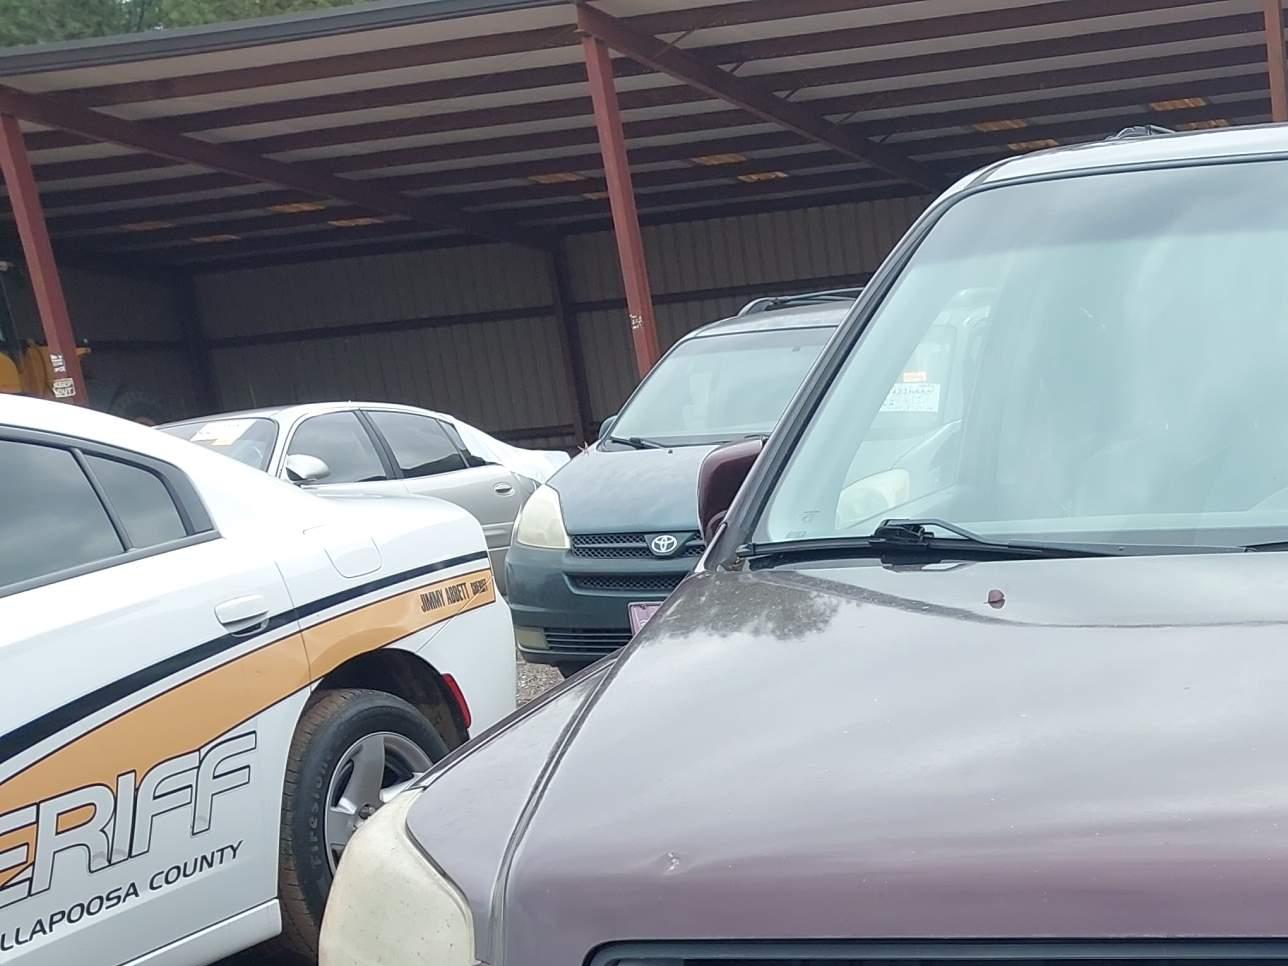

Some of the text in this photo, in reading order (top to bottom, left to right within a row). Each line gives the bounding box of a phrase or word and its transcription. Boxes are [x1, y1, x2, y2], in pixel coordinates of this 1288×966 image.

[420, 588, 446, 613] JIMMY
[0, 840, 244, 951] LLAPOOSA COUNTY
